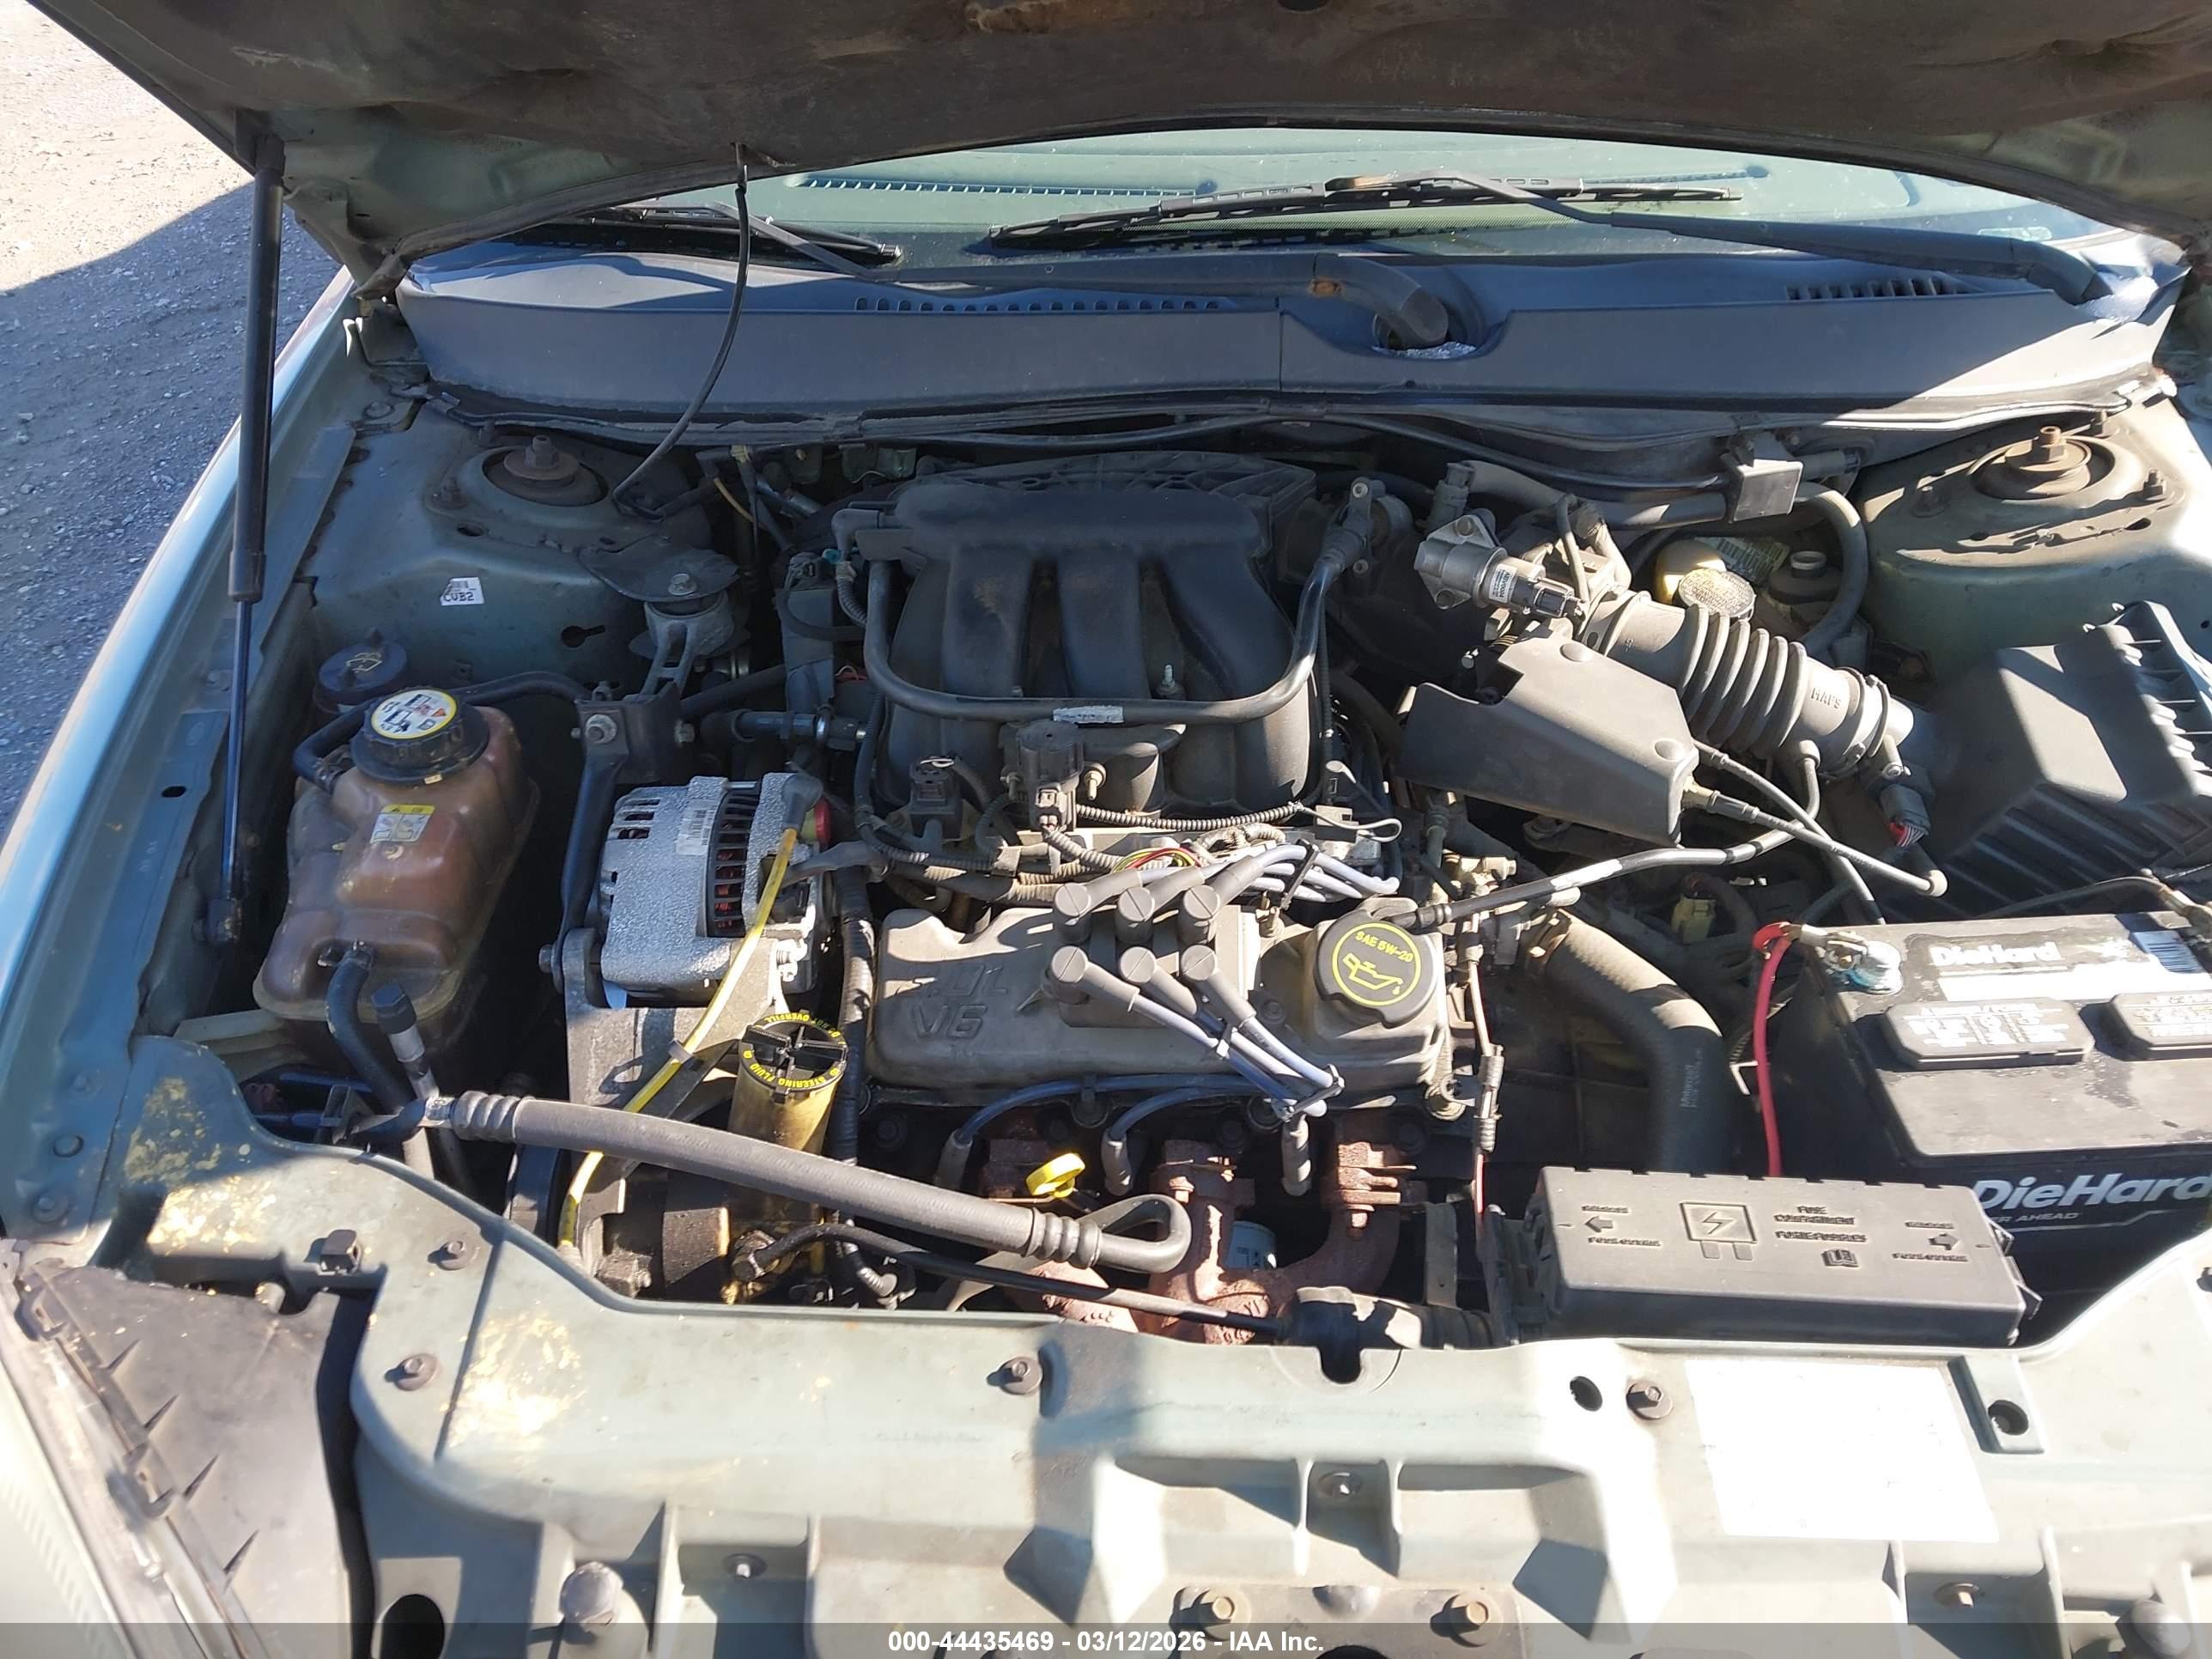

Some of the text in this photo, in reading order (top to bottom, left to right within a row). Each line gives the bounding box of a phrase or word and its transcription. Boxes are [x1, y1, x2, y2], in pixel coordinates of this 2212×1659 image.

[1356, 931, 1414, 963] SAE 5W-20
[1929, 941, 2062, 966] DieHard
[763, 1012, 810, 1024] OVERFILL
[912, 1003, 988, 1039] V6
[749, 1062, 826, 1088] STEERING FLUID
[2015, 1212, 2080, 1222] AHEAD
